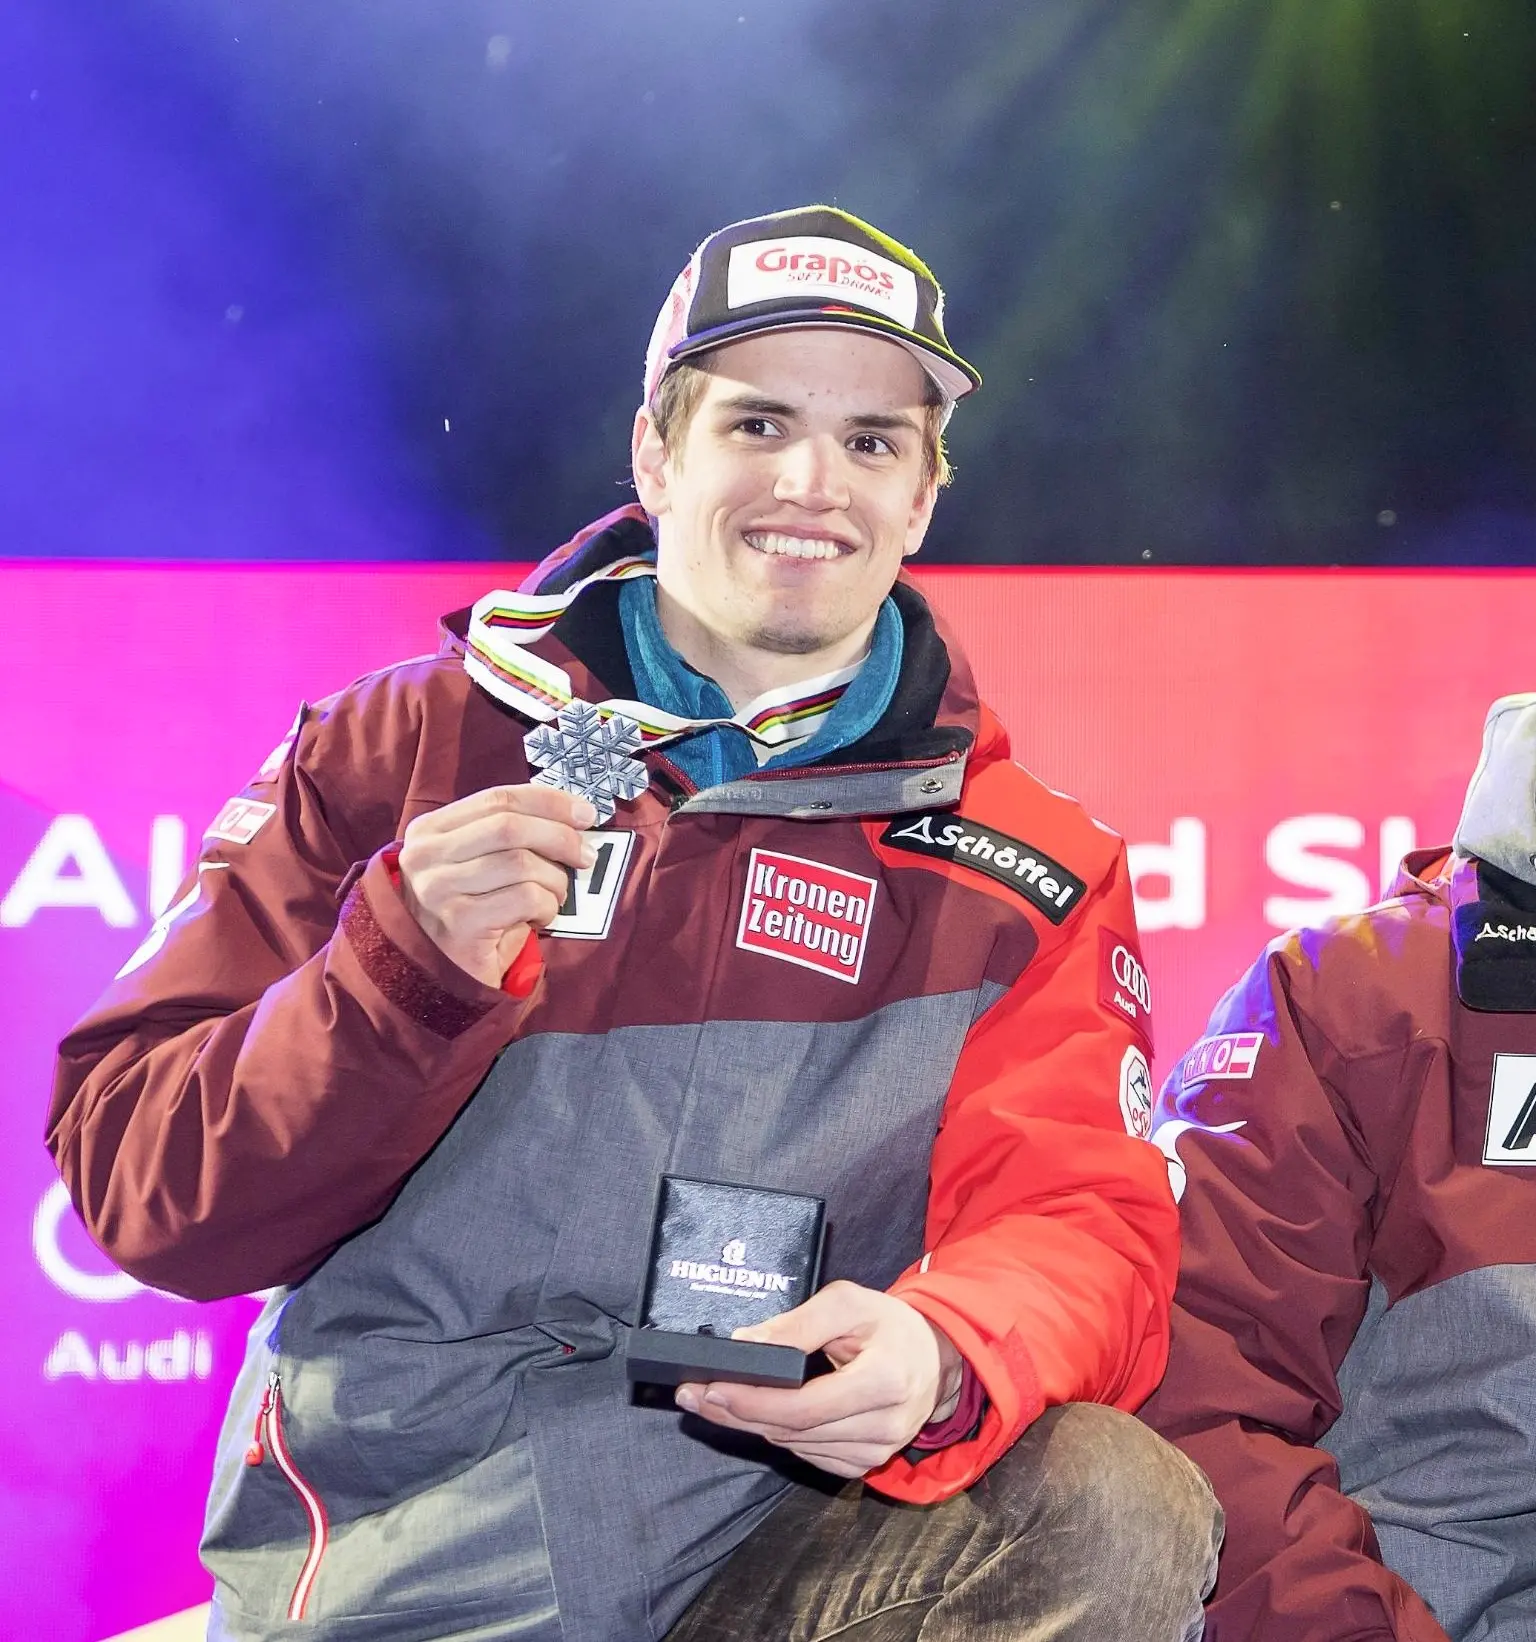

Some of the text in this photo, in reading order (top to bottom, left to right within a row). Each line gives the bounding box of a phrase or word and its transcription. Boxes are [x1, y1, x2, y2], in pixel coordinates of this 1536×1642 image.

[934, 822, 1074, 909] Schöffel
[752, 864, 867, 926] Kronen
[748, 898, 862, 966] Zeitung
[1113, 991, 1137, 1018] Audi
[670, 1260, 790, 1291] HUGUENIN
[44, 1331, 213, 1381] Audi
